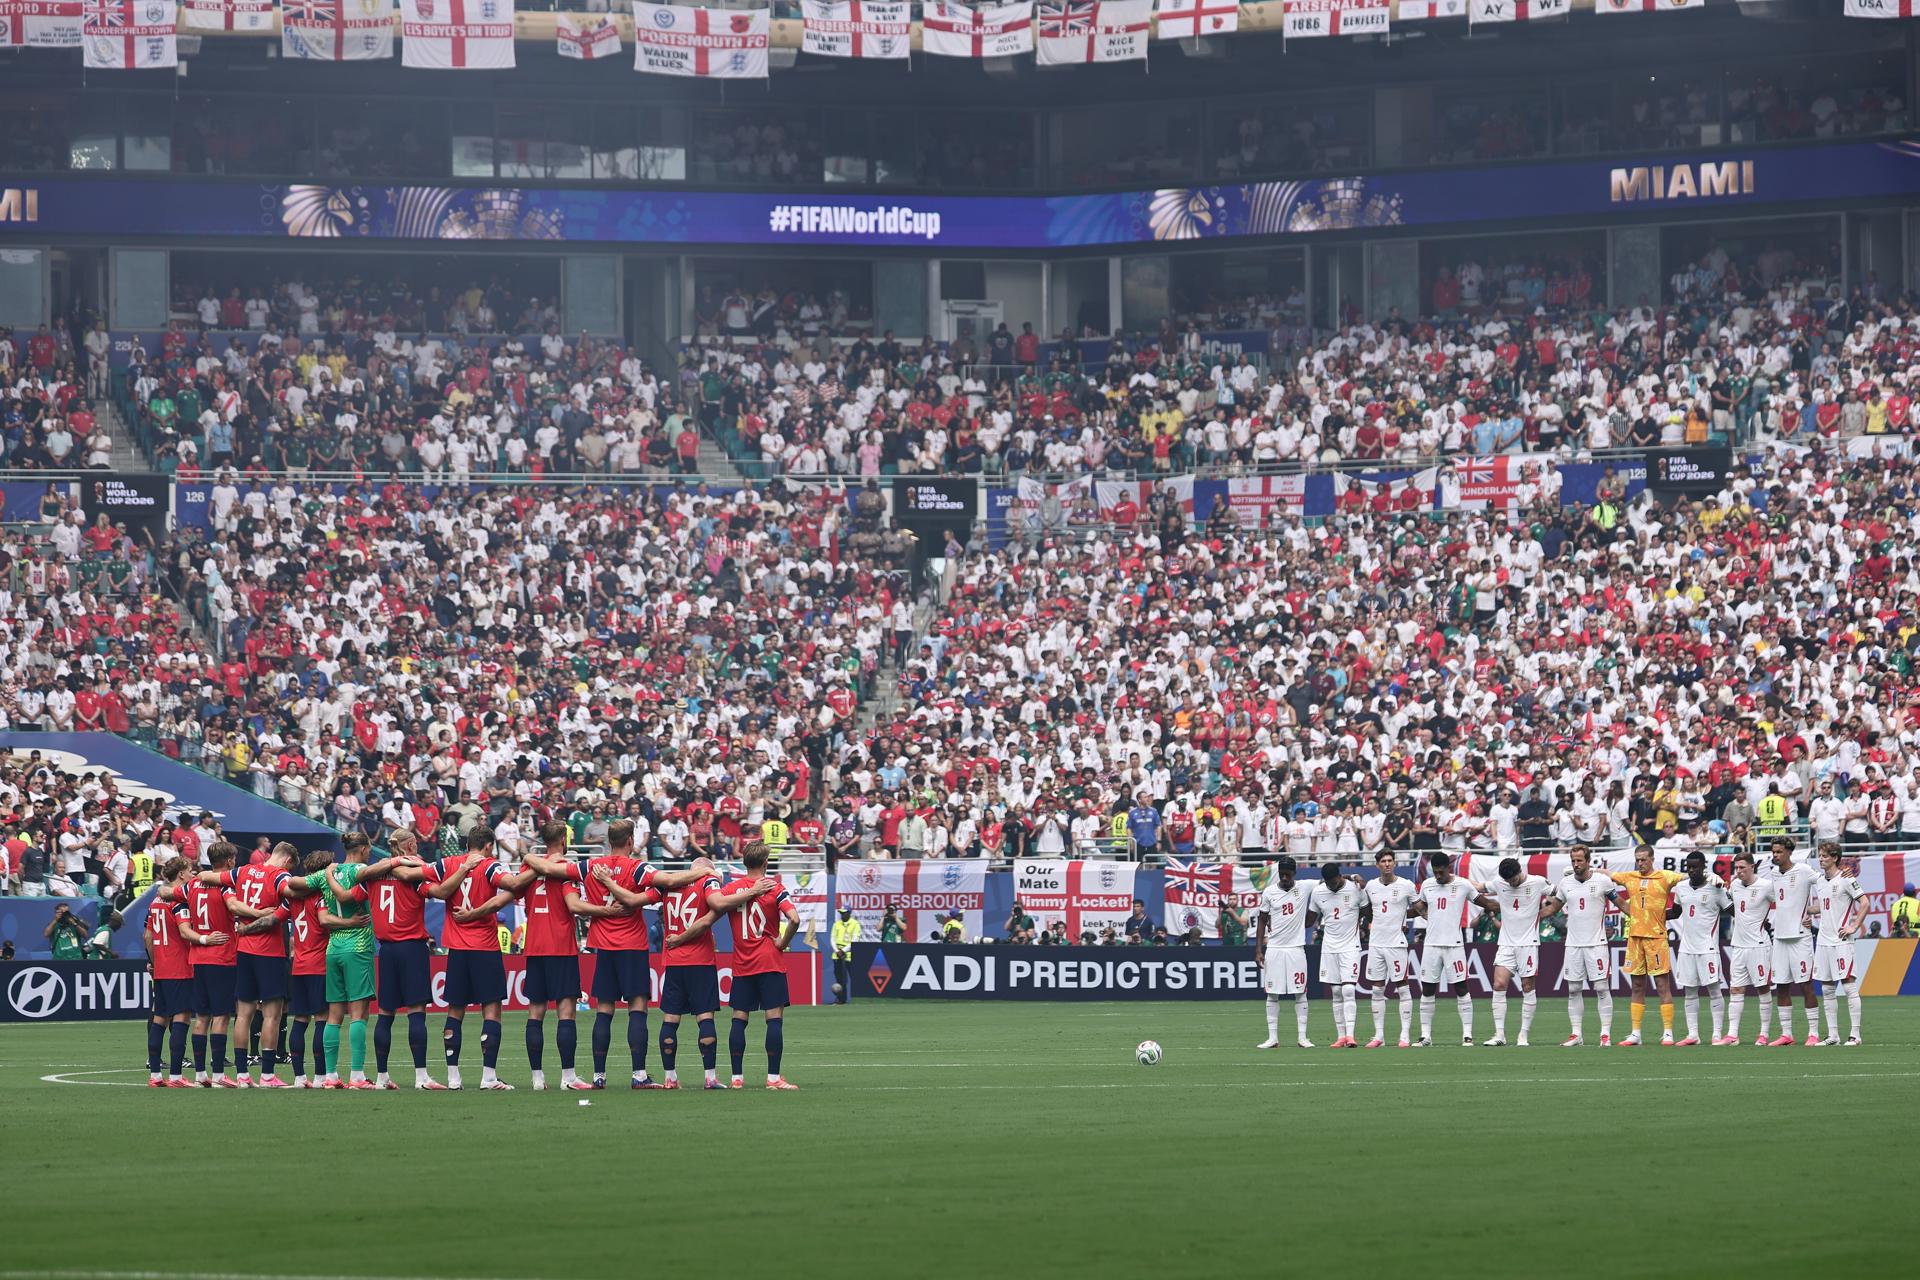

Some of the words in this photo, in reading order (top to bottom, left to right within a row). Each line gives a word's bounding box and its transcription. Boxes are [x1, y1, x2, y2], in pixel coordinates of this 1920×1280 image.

[47, 4, 60, 14] FC
[235, 3, 263, 11] KENT
[1290, 0, 1360, 12] ARSENAL
[290, 19, 331, 28] LEEDS
[347, 17, 394, 28] UNITED
[1293, 18, 1320, 30] 1886
[86, 26, 148, 35] HUDDERSFIELD
[149, 26, 174, 34] TOWN
[952, 23, 1004, 35] FULHAM
[1059, 26, 1105, 37] FULHAM
[1111, 25, 1127, 34] FC
[639, 30, 742, 47] PORTSMOUTH
[746, 35, 765, 46] FC
[1108, 37, 1134, 46] NICE
[643, 47, 688, 60] WALTON
[1106, 48, 1136, 57] GUYS
[648, 57, 683, 69] BLUES
[1611, 160, 1754, 202] MIAMI
[770, 205, 941, 240] #FIFAWorldCup
[1629, 467, 1647, 478] 129
[1669, 465, 1698, 473] WORLD
[1687, 472, 1715, 480] 2026
[105, 481, 124, 489] FIFA
[184, 492, 204, 503] 126
[918, 494, 948, 502] WORLD
[1231, 496, 1276, 504] NOTTINGHAM
[918, 502, 934, 510] CUP
[936, 502, 964, 510] 2026
[1025, 866, 1055, 877] Our
[1019, 879, 1060, 889] Mate
[242, 879, 264, 909] 17
[1779, 888, 1785, 901] 3
[380, 885, 395, 924] 9
[840, 894, 979, 911] MIDDLESBROUGH
[1072, 896, 1129, 908] Lockett
[1382, 901, 1388, 913] 5
[1437, 898, 1447, 910] 10
[1513, 898, 1520, 911] 4
[1579, 898, 1586, 910] 9
[1641, 896, 1645, 909] 1
[1740, 901, 1745, 913] 8
[1823, 897, 1831, 910] 18
[196, 893, 210, 930] 5
[667, 892, 698, 930] 26
[1282, 903, 1294, 916] 20
[1334, 908, 1340, 920] 2
[1689, 904, 1695, 918] 6
[295, 907, 308, 942] 6
[738, 902, 766, 940] 10
[1083, 920, 1104, 928] Leek
[1394, 960, 1400, 972] 5
[1527, 955, 1533, 968] 4
[1597, 959, 1604, 971] 9
[1655, 954, 1660, 966] 1
[1837, 957, 1846, 971] 18
[1353, 962, 1359, 975] 2
[1453, 960, 1464, 973] 10
[1708, 962, 1715, 974] 6
[1758, 965, 1764, 977] 8
[1800, 960, 1806, 973] 3
[900, 955, 995, 992] ADI
[1009, 960, 1267, 988] PREDICTSTRE
[1295, 973, 1305, 985] 20
